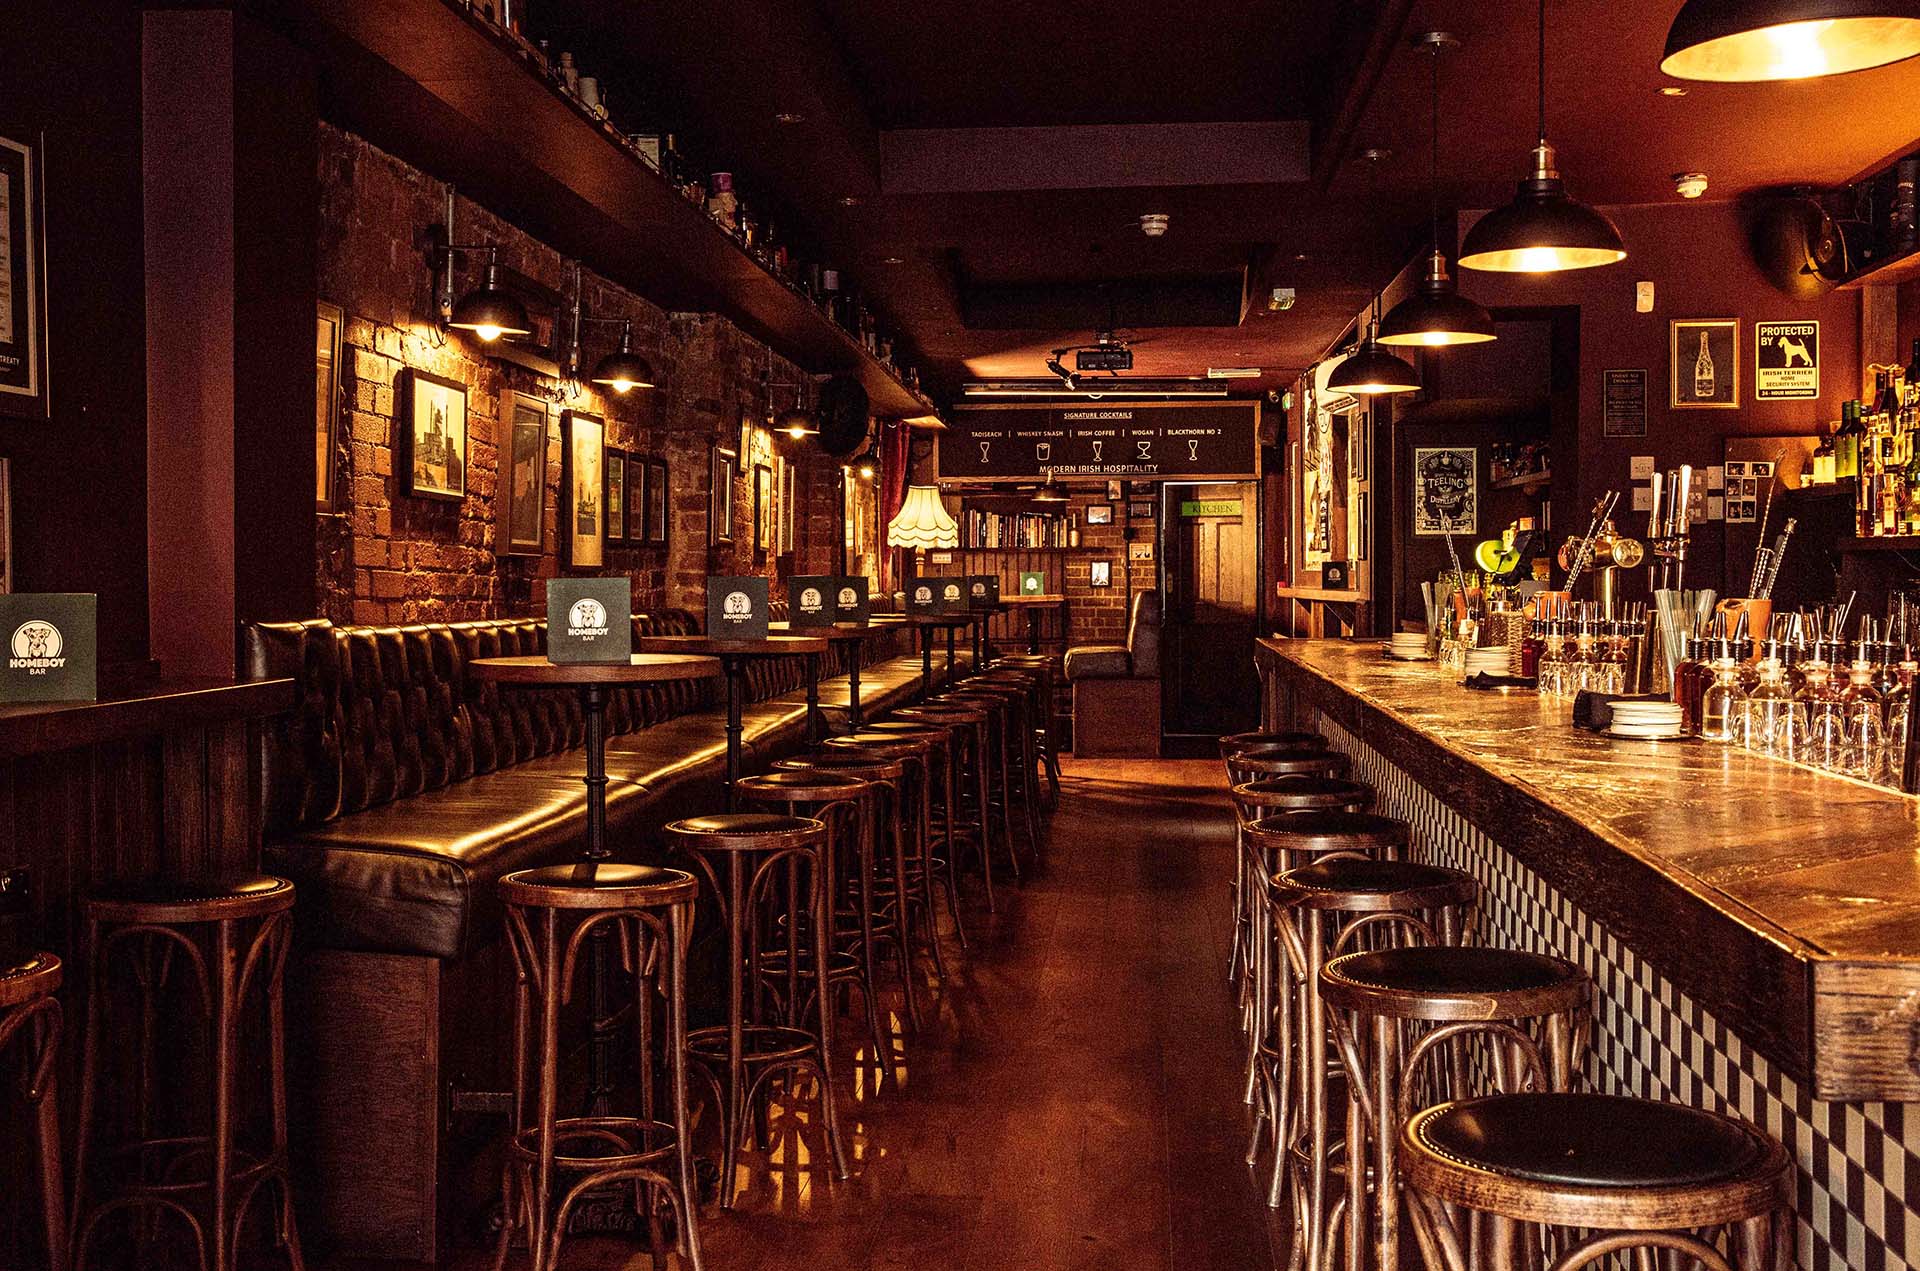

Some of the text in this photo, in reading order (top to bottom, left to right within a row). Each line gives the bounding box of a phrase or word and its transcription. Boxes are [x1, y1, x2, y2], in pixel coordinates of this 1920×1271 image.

[1760, 326, 1814, 336] PROTECTED
[1760, 337, 1774, 346] BY
[1039, 464, 1158, 473] MODERN IRISH HOSPITALITY
[1427, 477, 1464, 489] TEELING
[1192, 504, 1233, 513] KITCHEN
[568, 627, 609, 636] HOMEBOY
[9, 657, 66, 668] HOMEBOY
